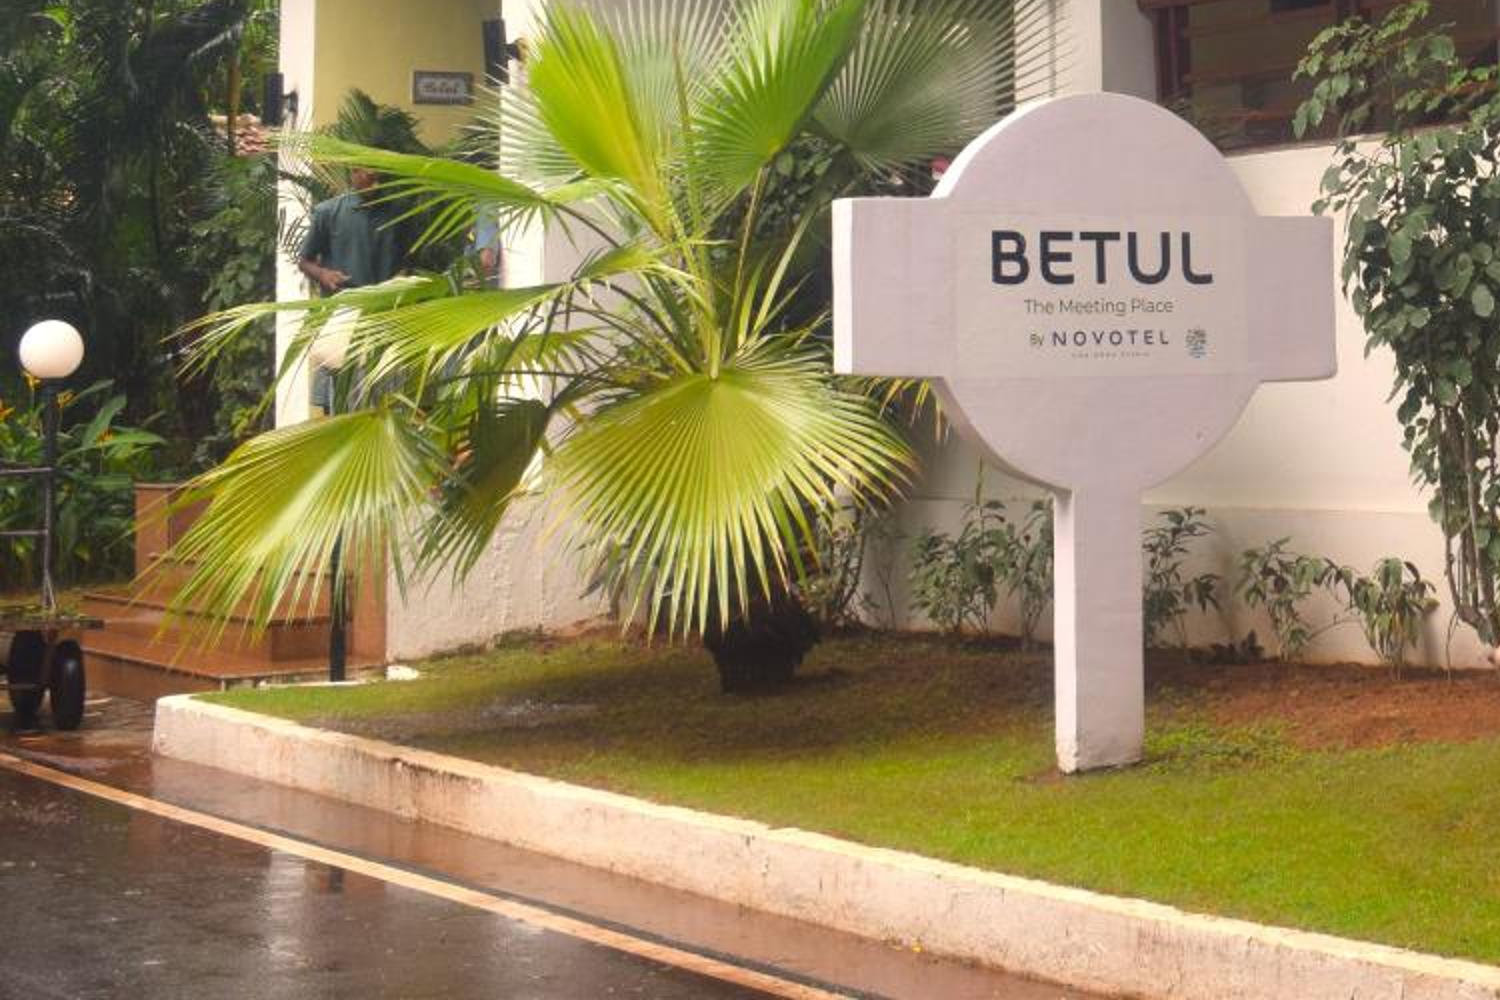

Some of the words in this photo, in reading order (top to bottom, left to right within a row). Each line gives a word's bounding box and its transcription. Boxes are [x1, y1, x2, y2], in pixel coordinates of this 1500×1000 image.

[991, 230, 1213, 285] BETUL
[1024, 299, 1054, 314] The
[1059, 299, 1127, 316] Meeting
[1131, 298, 1174, 313] Place
[1052, 330, 1169, 346] NOVOTEL
